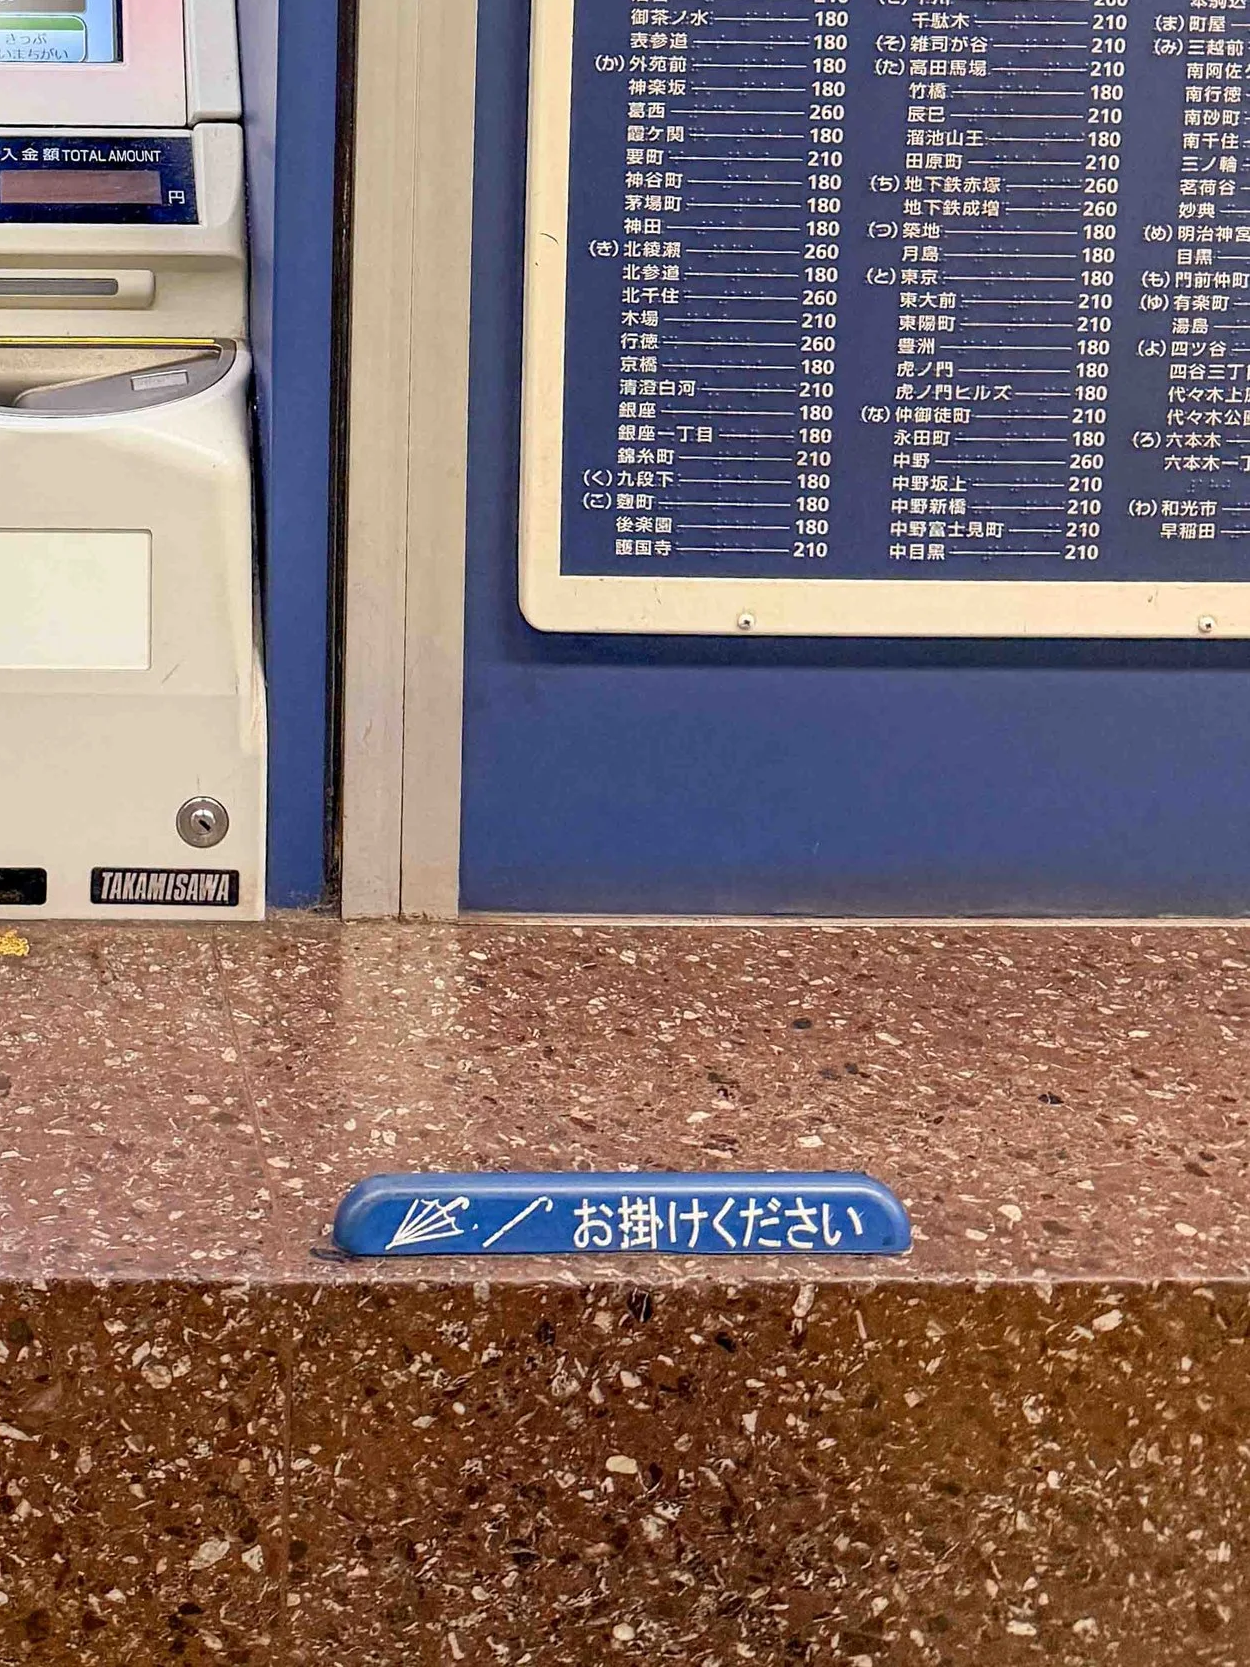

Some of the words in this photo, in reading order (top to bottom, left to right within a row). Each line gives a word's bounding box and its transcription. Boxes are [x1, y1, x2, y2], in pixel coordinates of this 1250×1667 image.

[1187, 40, 1244, 57] 三越前
[909, 59, 987, 77] 高田馬場
[1090, 62, 1125, 78] 210
[62, 150, 106, 163] TOTAL
[108, 150, 162, 163] AMOUNT
[168, 190, 186, 205] 円
[901, 268, 938, 285] 東京
[1080, 271, 1114, 287] 180
[618, 401, 656, 419] 銀座
[799, 405, 833, 421] 180
[1165, 432, 1221, 449] 六本木
[889, 542, 945, 560] 中目黒
[1064, 545, 1099, 560] 210
[101, 871, 230, 902] TAKAMISAWA
[573, 1194, 864, 1250] お掛けください
